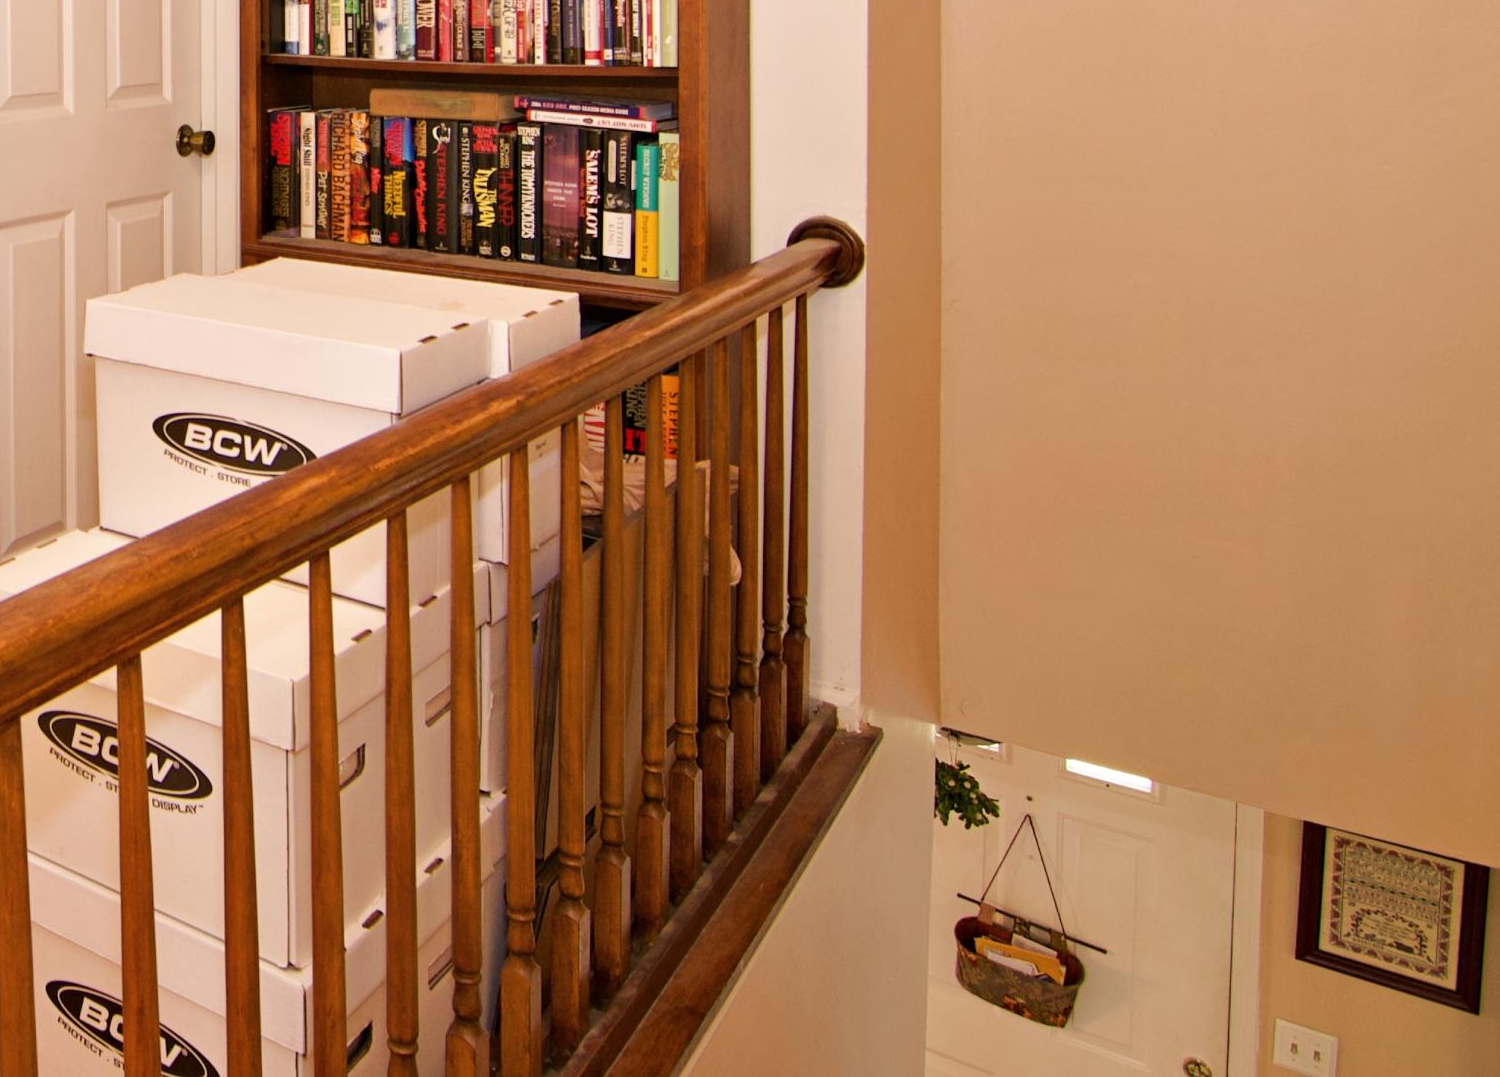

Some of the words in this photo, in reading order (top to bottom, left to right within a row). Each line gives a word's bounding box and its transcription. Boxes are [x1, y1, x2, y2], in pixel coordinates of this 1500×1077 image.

[302, 127, 312, 148] Night
[331, 112, 346, 171] RICHARD
[461, 137, 470, 177] STEPHEN
[436, 144, 447, 200] STEPHEN
[521, 150, 535, 168] THE
[586, 149, 602, 204] 'SALEM'S
[619, 169, 627, 186] LOT
[317, 170, 328, 192] PET
[383, 174, 394, 216] THINGS
[392, 170, 406, 219] NEEDFUL
[461, 179, 470, 203] KING
[473, 167, 498, 228] TALISMAN
[487, 188, 497, 203] THE
[499, 169, 514, 228] THINNER
[642, 177, 651, 209] WINDOWS
[331, 175, 346, 242] BACHMAN
[437, 203, 447, 235] KING
[521, 168, 535, 239] TOMMYKNOCKERS
[586, 207, 598, 238] LOT
[608, 223, 616, 246] KING
[616, 216, 624, 255] STEPHEN
[640, 215, 650, 243] Stephen
[641, 245, 650, 263] King
[669, 392, 679, 455] STEPHEN
[184, 422, 283, 466] BCW
[164, 449, 208, 476] PROTECT
[217, 472, 251, 488] STORE
[49, 747, 97, 783] PROTECT
[151, 798, 198, 815] DISPLAY
[57, 1016, 104, 1057] PROTECT
